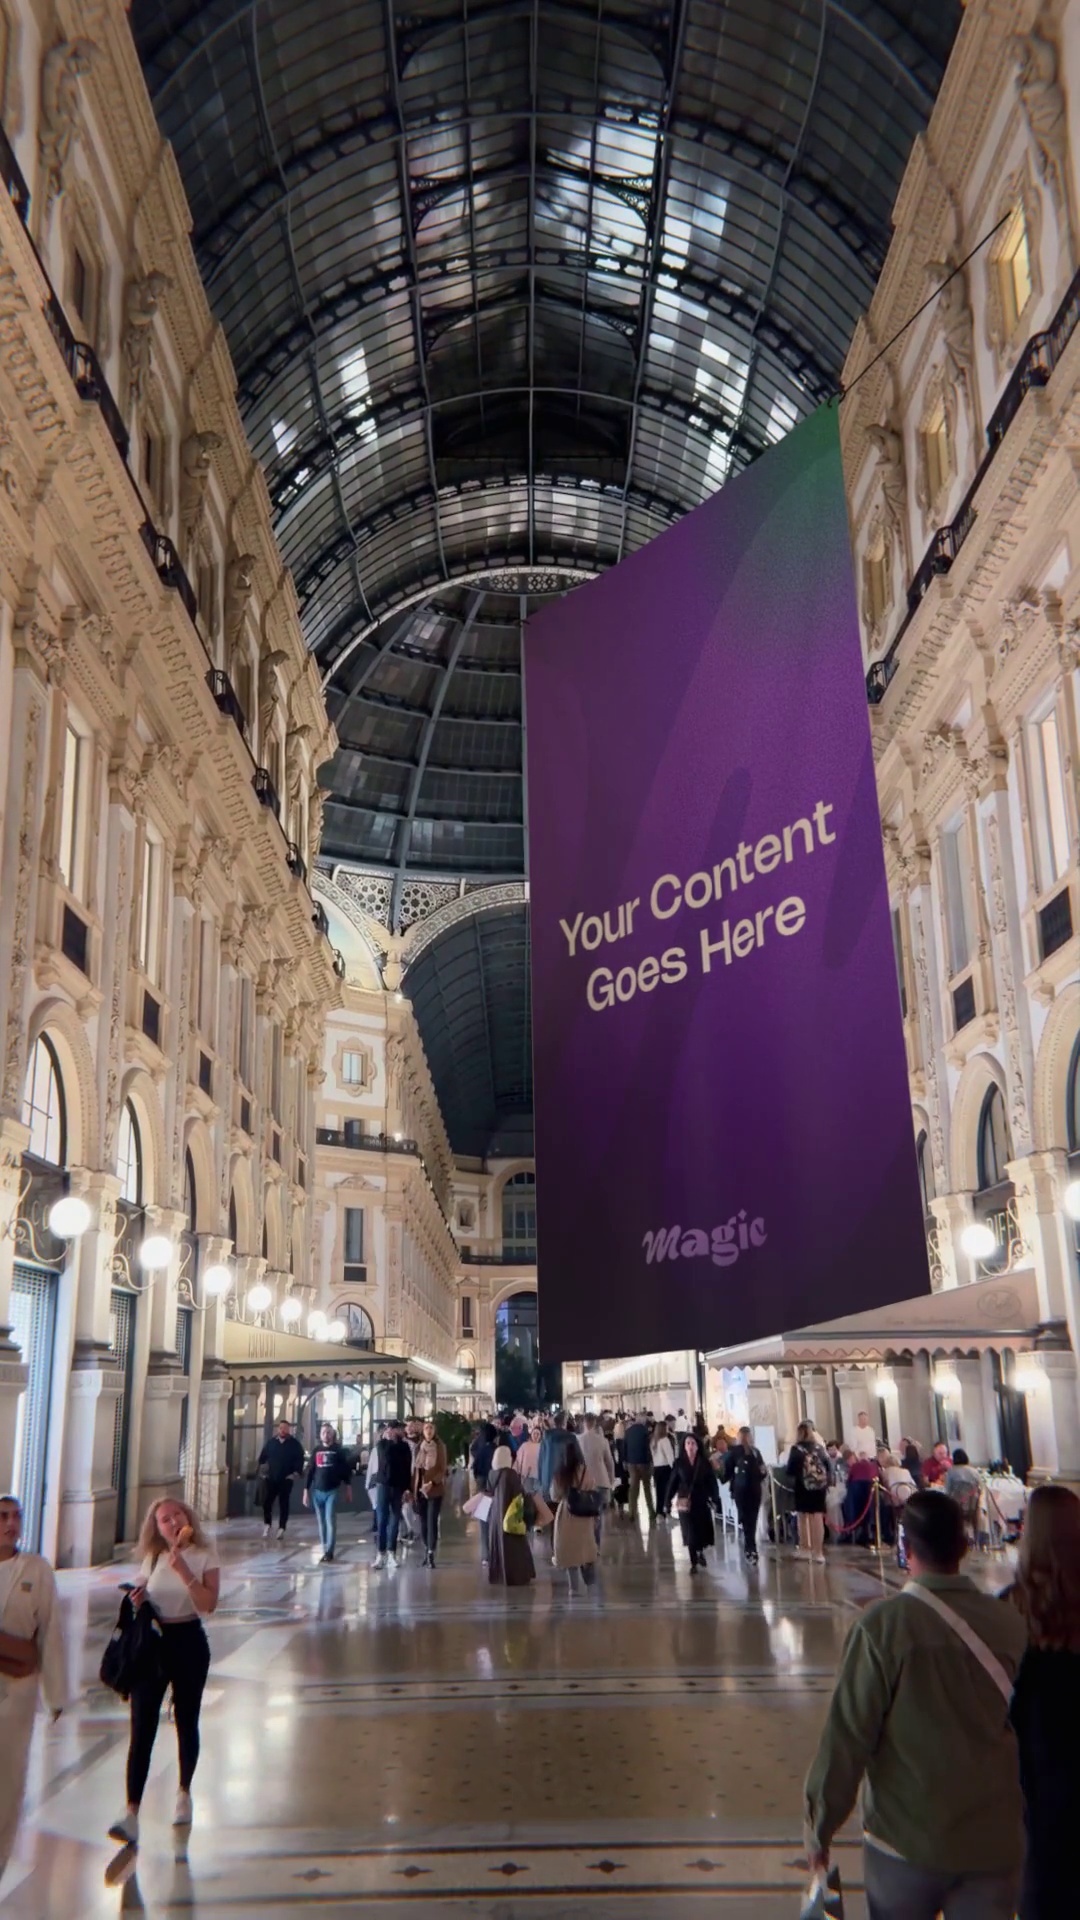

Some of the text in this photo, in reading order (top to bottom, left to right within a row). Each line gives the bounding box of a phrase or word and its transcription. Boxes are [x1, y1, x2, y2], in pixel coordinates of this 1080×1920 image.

[559, 800, 836, 957] Your Content
[586, 895, 806, 1012] Goes Here
